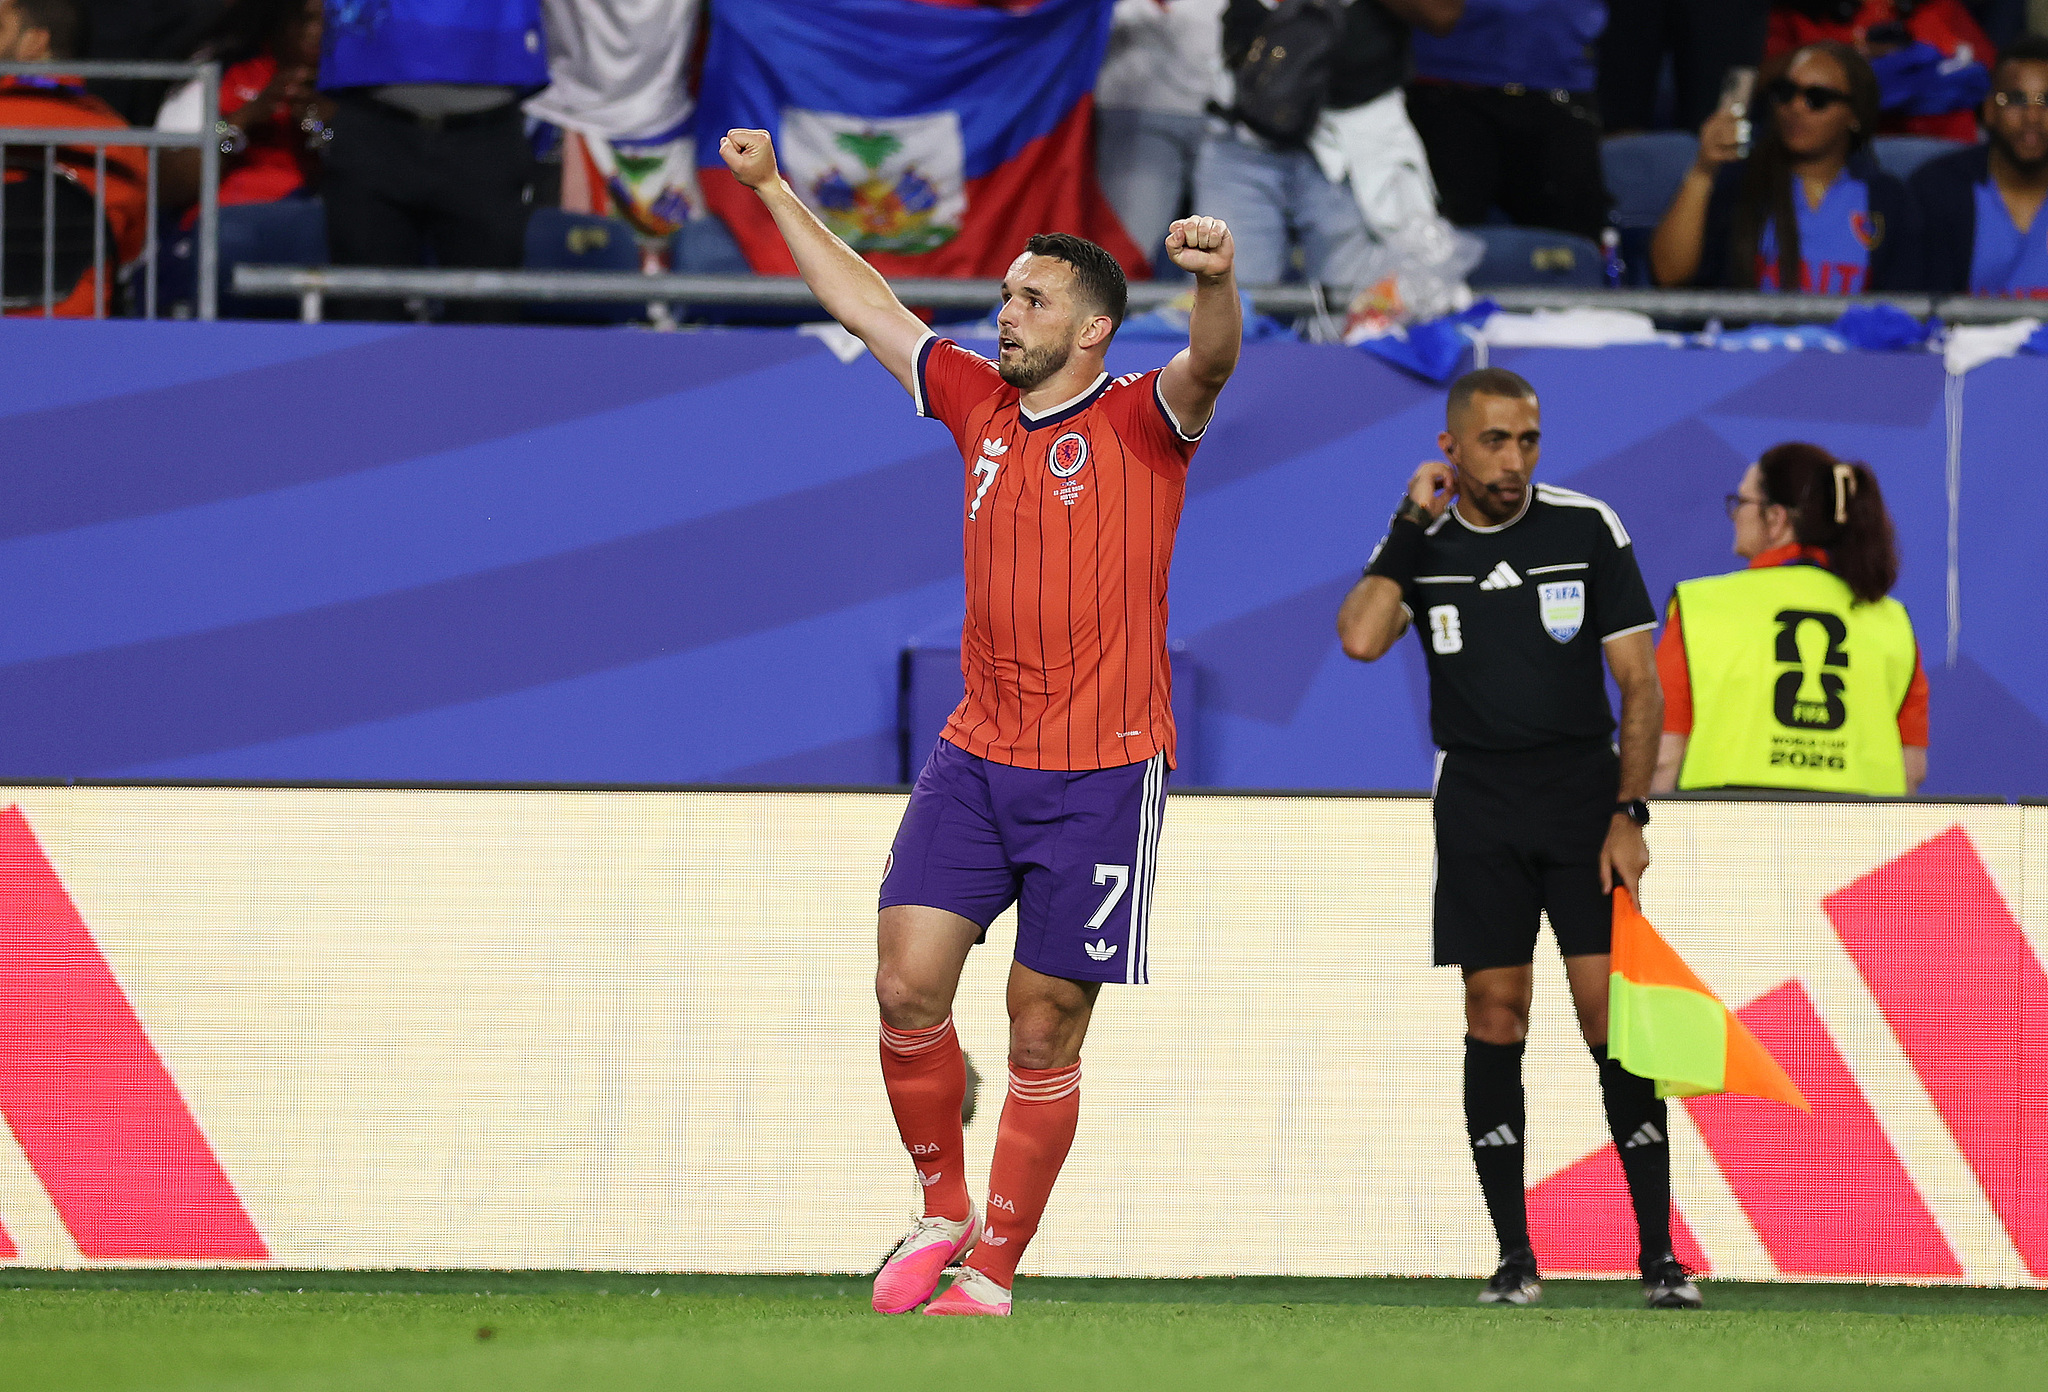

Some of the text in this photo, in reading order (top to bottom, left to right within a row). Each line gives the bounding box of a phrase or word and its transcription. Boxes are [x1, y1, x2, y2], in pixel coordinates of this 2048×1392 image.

[968, 455, 1001, 522] 7
[1545, 586, 1580, 600] FIFA
[1770, 752, 1846, 771] 2026
[1083, 863, 1130, 930] 7
